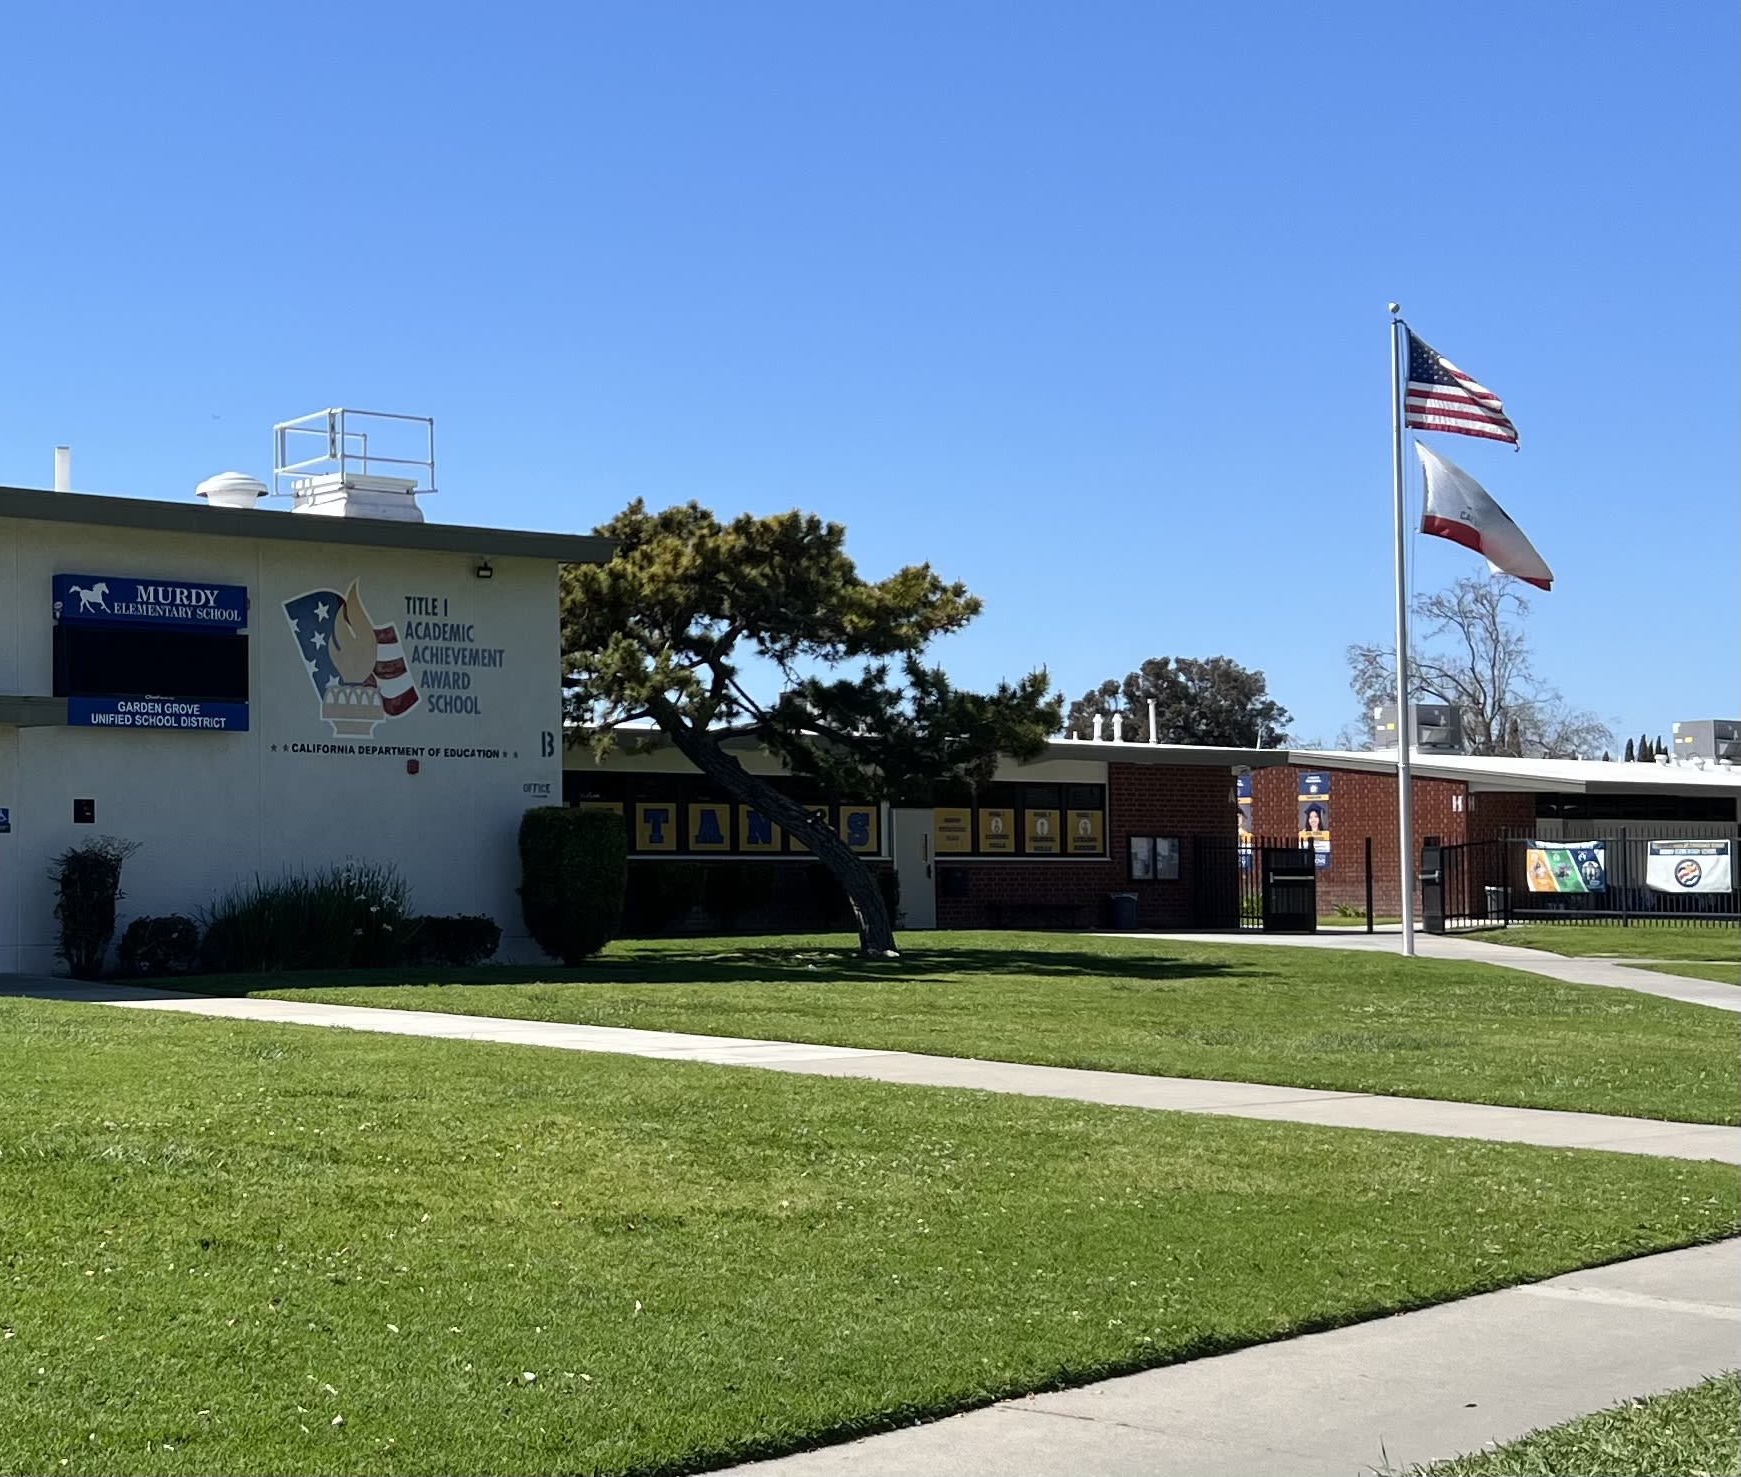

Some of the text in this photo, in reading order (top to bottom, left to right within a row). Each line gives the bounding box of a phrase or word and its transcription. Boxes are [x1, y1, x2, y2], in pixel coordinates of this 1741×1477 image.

[135, 584, 220, 607] MURDY
[114, 602, 241, 622] ELEMENTARY SCHOOL
[404, 596, 439, 617] TITLE
[404, 621, 474, 643] ACADEMIC
[411, 646, 505, 668] ACHIEVEMENT
[420, 670, 471, 690] AWARD
[117, 701, 201, 715] GARDEN GROVE
[428, 694, 481, 715] SCHOOL
[90, 713, 227, 728] UNIFIED SCHOOL DISTRICT
[291, 743, 500, 759] CALIFORNIA DEPARTMENT OF EDUCATION
[541, 731, 555, 757] B
[523, 784, 551, 793] OFFICE
